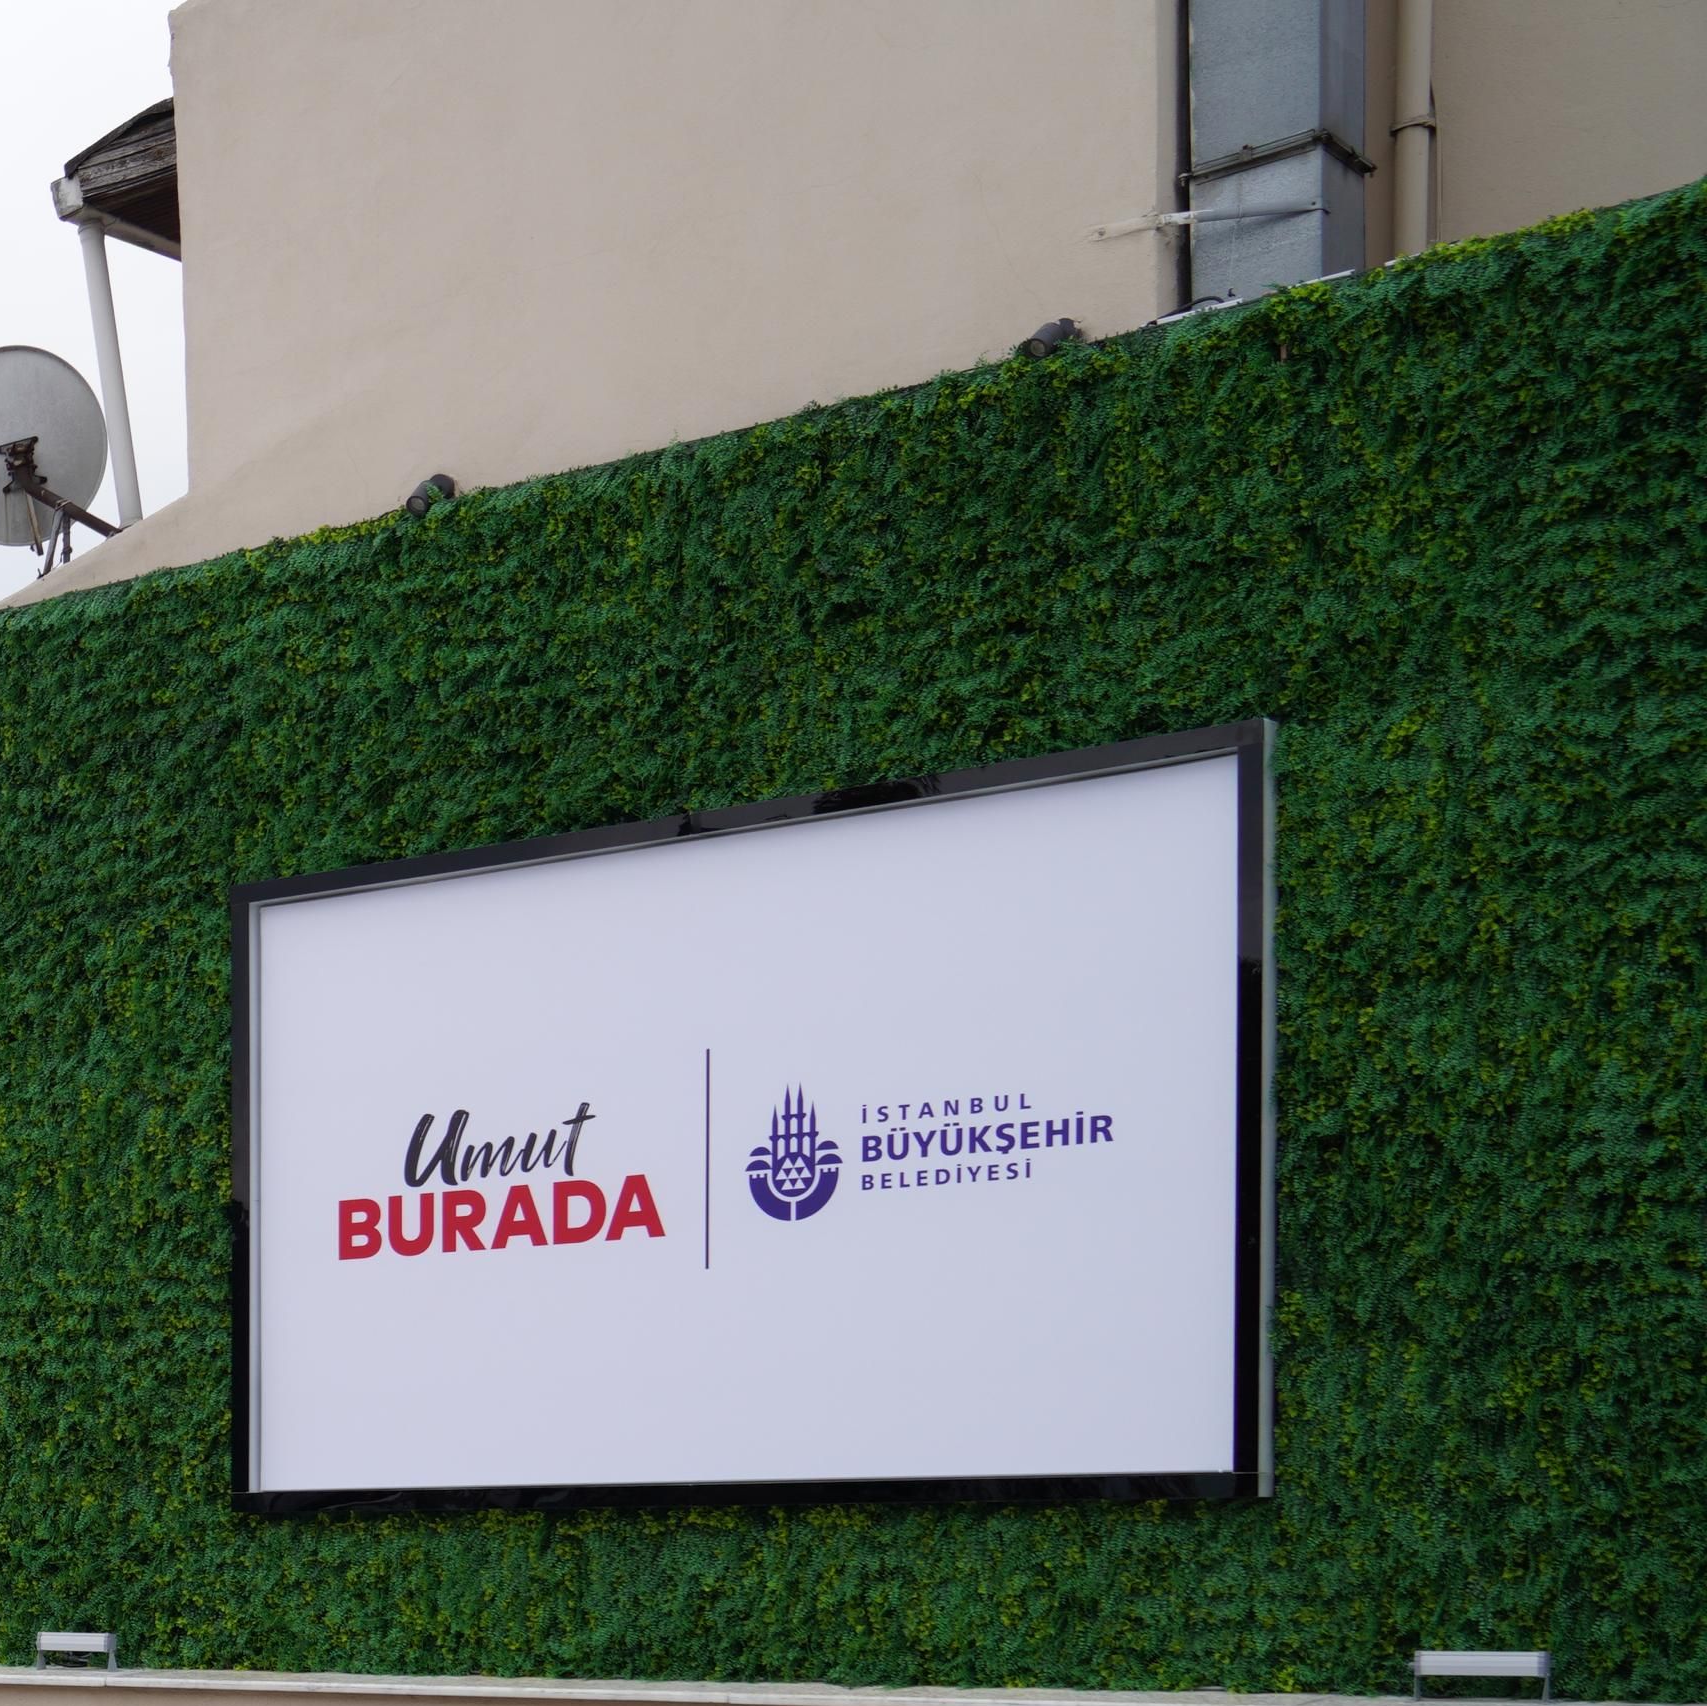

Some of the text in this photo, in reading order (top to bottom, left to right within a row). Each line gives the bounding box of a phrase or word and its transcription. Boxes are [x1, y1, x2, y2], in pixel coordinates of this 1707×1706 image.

[861, 1093, 1032, 1124] İSTANBUL
[403, 1101, 596, 1188] Umut
[861, 1110, 1114, 1163] BÜYÜKŞEHİR
[861, 1158, 1032, 1191] BELEDİYESİ
[338, 1173, 666, 1261] BURADA
